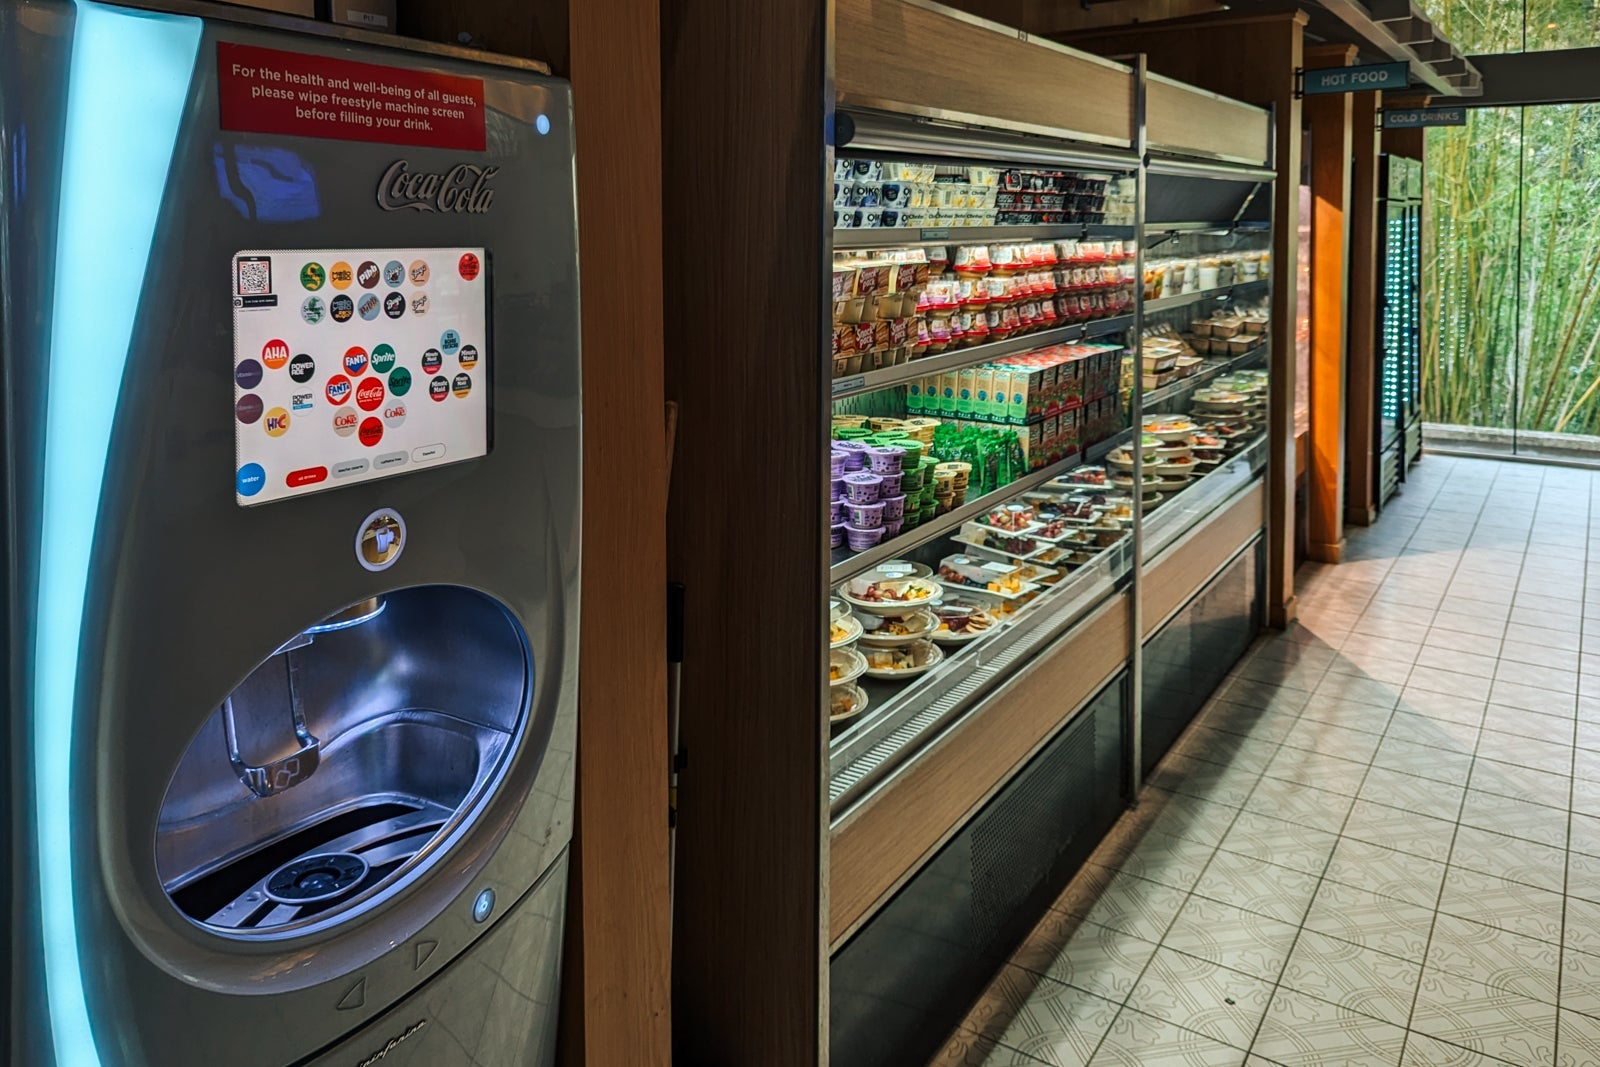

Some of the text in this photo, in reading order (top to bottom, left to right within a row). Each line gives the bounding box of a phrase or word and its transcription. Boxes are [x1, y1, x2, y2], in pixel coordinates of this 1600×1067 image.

[1321, 70, 1388, 86] HOT FOOD
[232, 64, 477, 108] For the health and well-being of all guests,
[252, 85, 465, 120] please wipe freestyle machine screen
[296, 106, 433, 131] before filling your drink.
[1390, 112, 1460, 123] COLD DRINKS
[377, 160, 500, 214] Coca-Cola
[264, 346, 288, 360] AHA
[372, 352, 395, 364] Sprite
[291, 362, 314, 370] POWER
[242, 475, 260, 484] water
